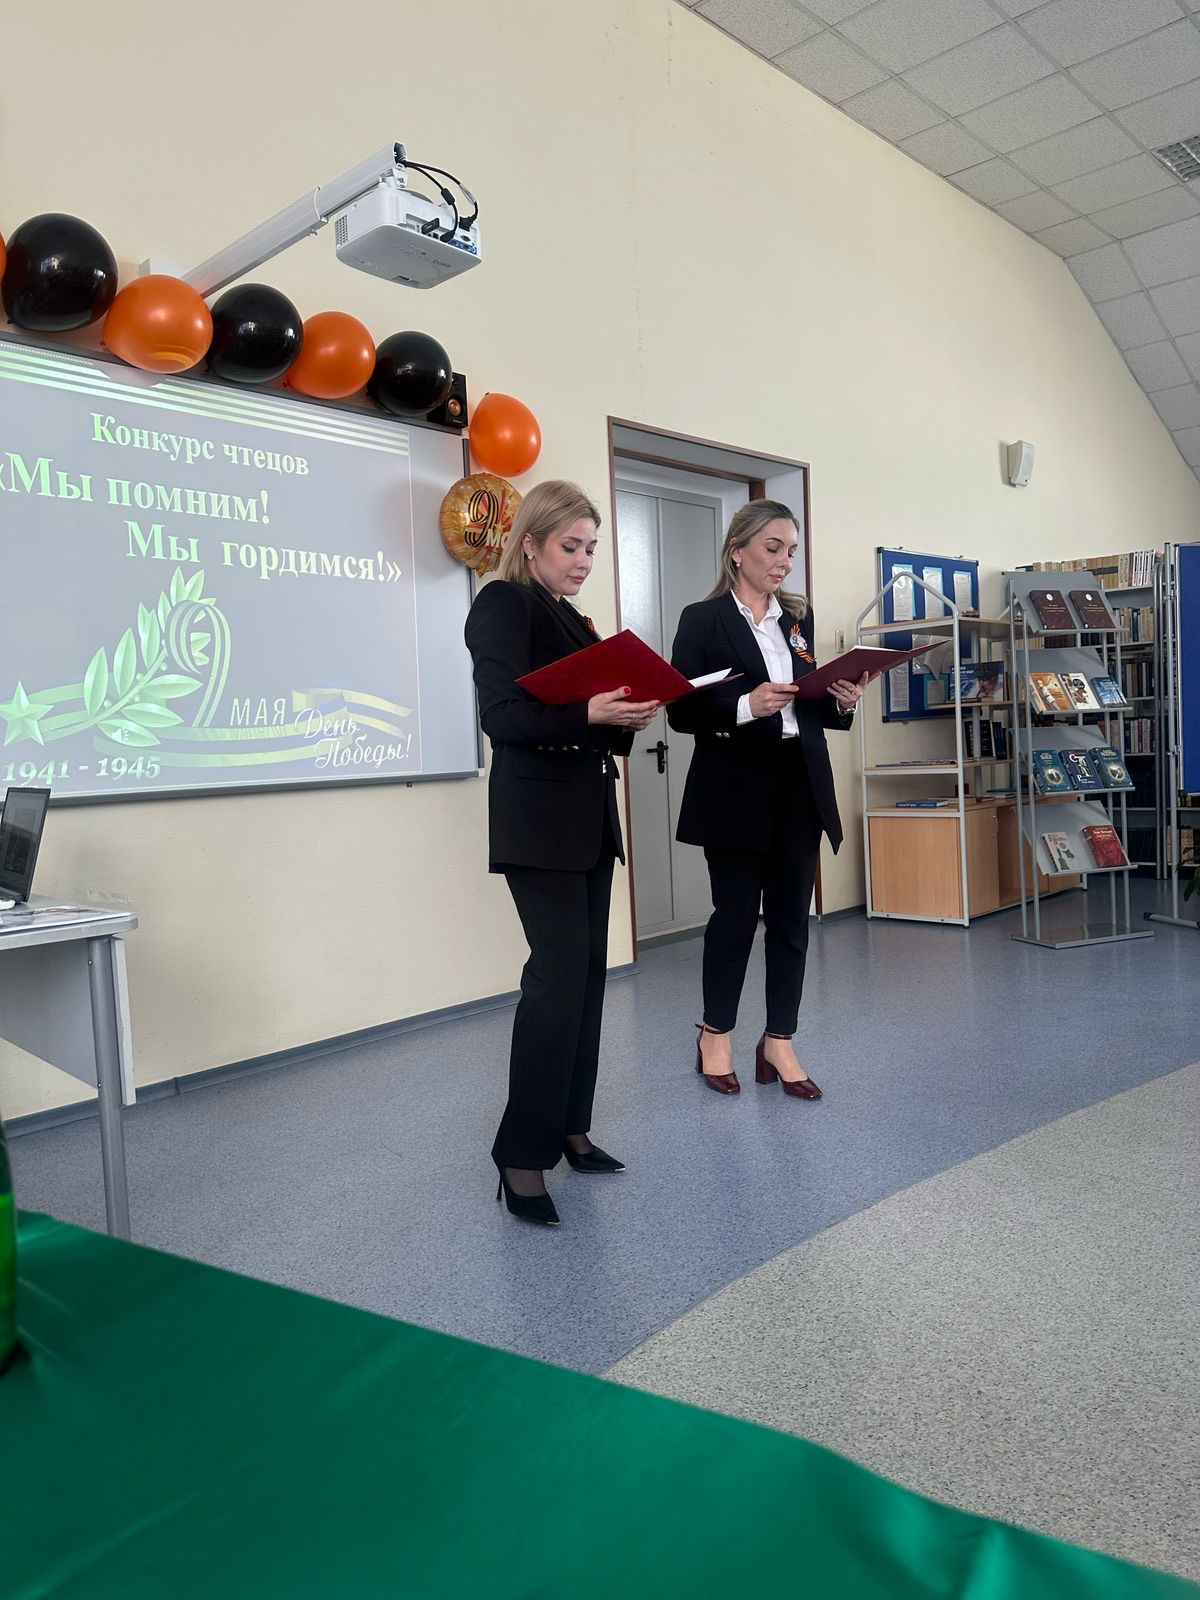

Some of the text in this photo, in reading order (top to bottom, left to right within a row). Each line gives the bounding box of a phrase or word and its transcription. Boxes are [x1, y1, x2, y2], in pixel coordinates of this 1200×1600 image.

[90, 412, 310, 476] Конкурс чтецов
[106, 476, 271, 525] помним!
[464, 489, 499, 548] 9
[124, 519, 403, 582] Мы гордимся!»
[230, 696, 288, 727] МАЯ
[294, 707, 360, 740] День
[1, 758, 70, 786] 1941
[97, 756, 162, 781] 1945
[314, 733, 413, 770] Победы!
